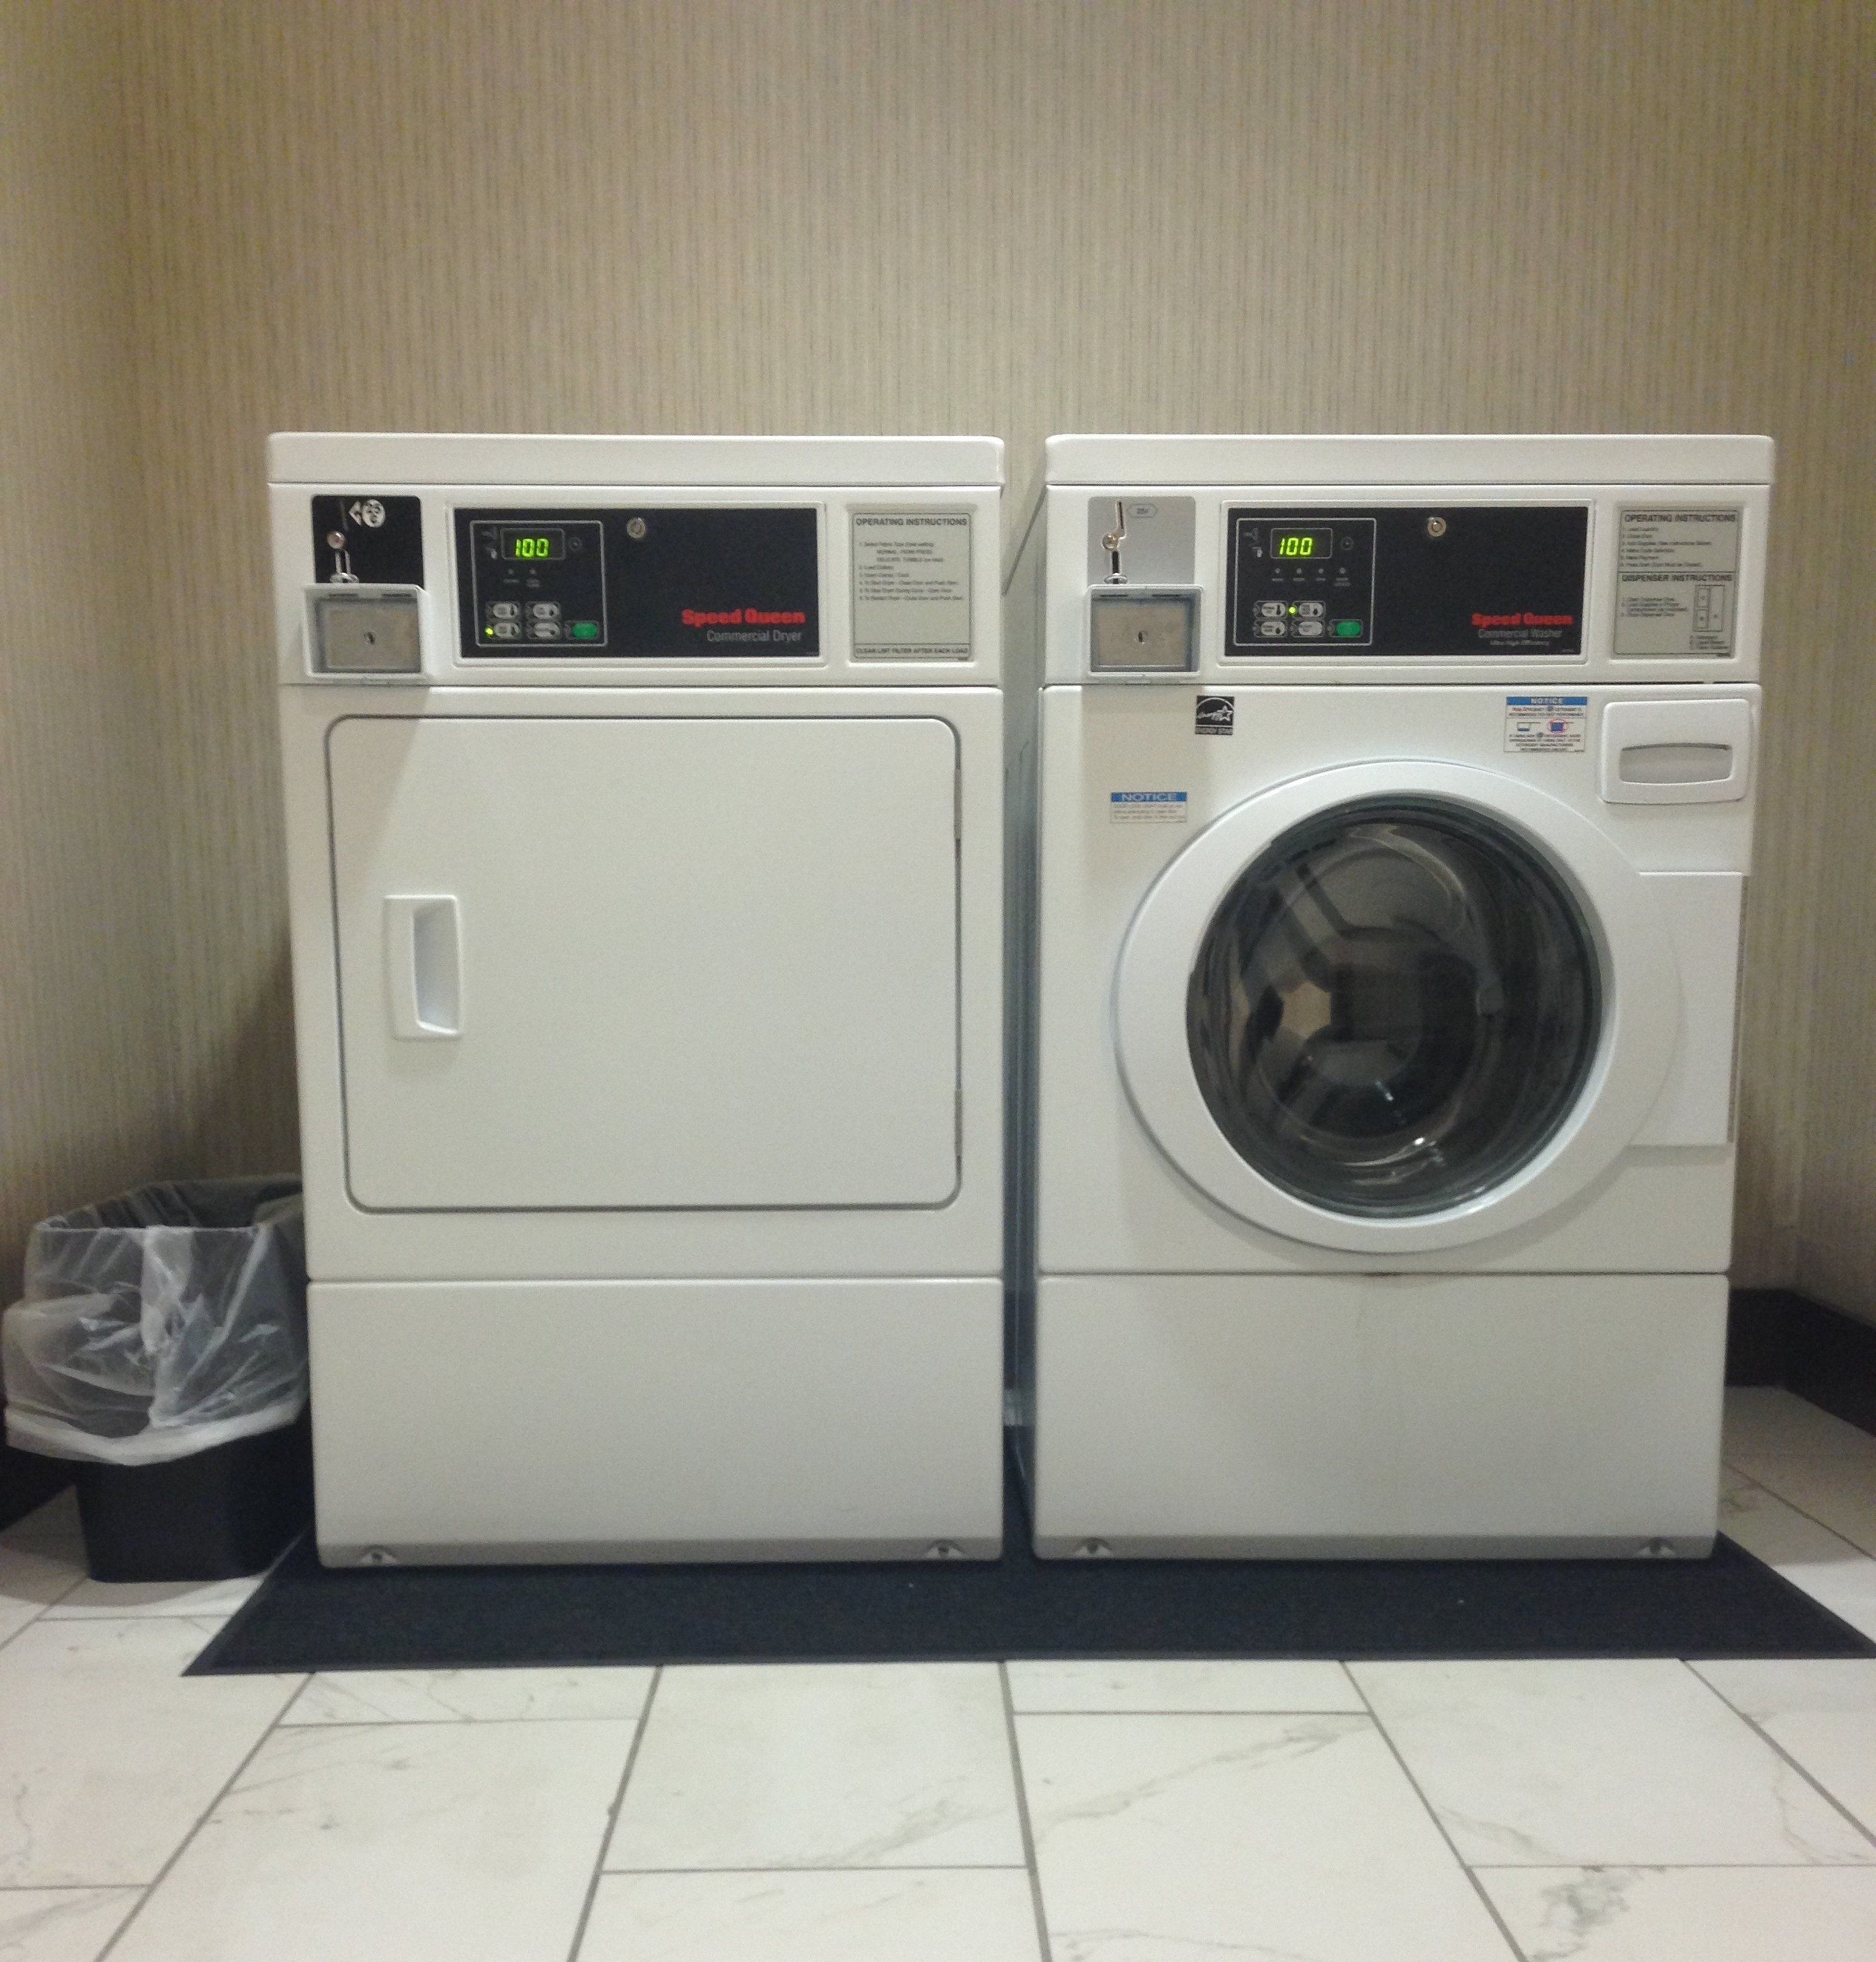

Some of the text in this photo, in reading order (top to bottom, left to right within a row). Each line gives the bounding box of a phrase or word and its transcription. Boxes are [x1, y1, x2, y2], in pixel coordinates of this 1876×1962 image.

[1674, 514, 1736, 522] INSTRUCTIONS
[515, 539, 549, 557] 100
[1279, 538, 1312, 555] 100
[682, 608, 805, 628] Speed Queen
[1471, 612, 1573, 628] Speed Queen
[707, 629, 802, 642] Commercial Dryer
[1478, 628, 1562, 638] Commercial Washer
[1122, 793, 1177, 801] NOTICE
